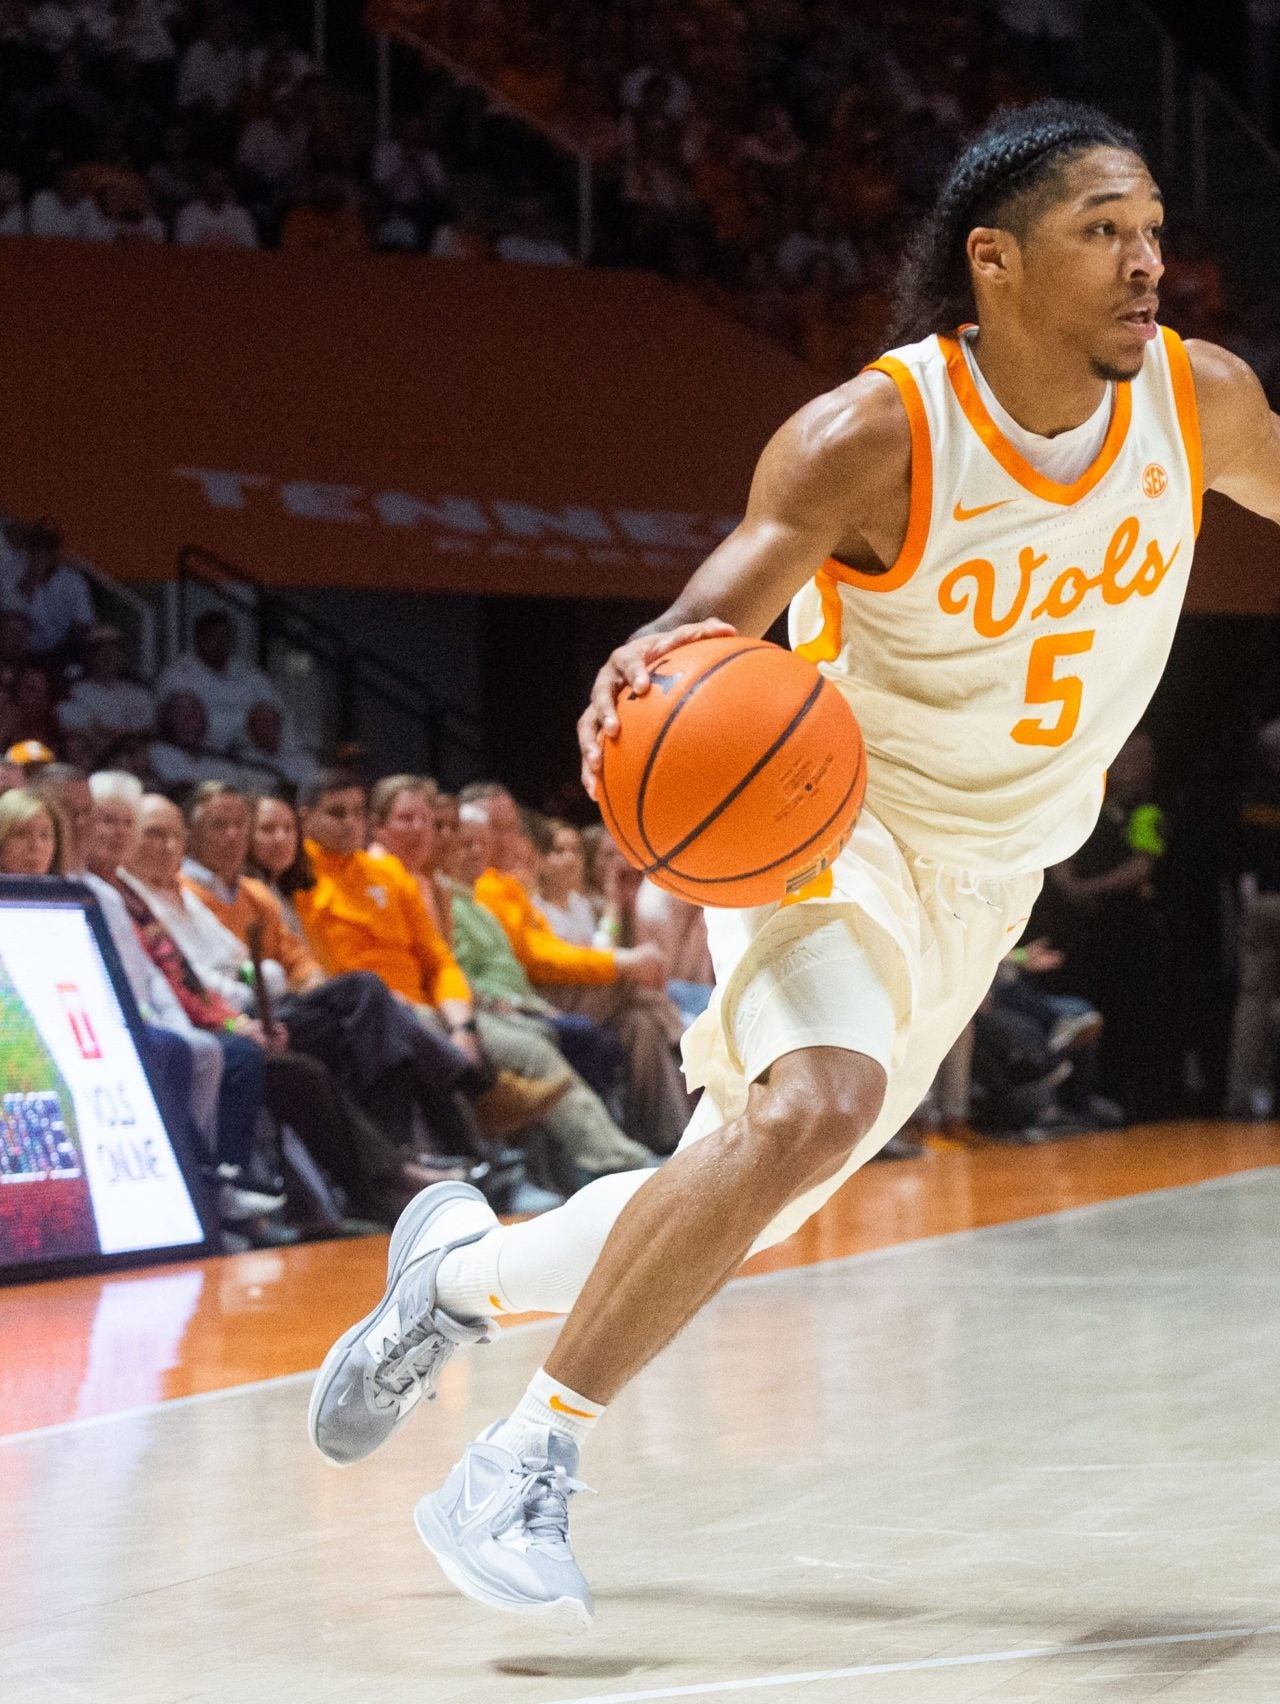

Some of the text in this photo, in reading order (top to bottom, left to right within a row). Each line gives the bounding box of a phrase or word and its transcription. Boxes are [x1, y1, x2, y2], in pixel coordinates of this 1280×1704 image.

[1143, 465, 1167, 496] SEC
[938, 516, 1182, 638] Vols
[1010, 629, 1096, 747] 5
